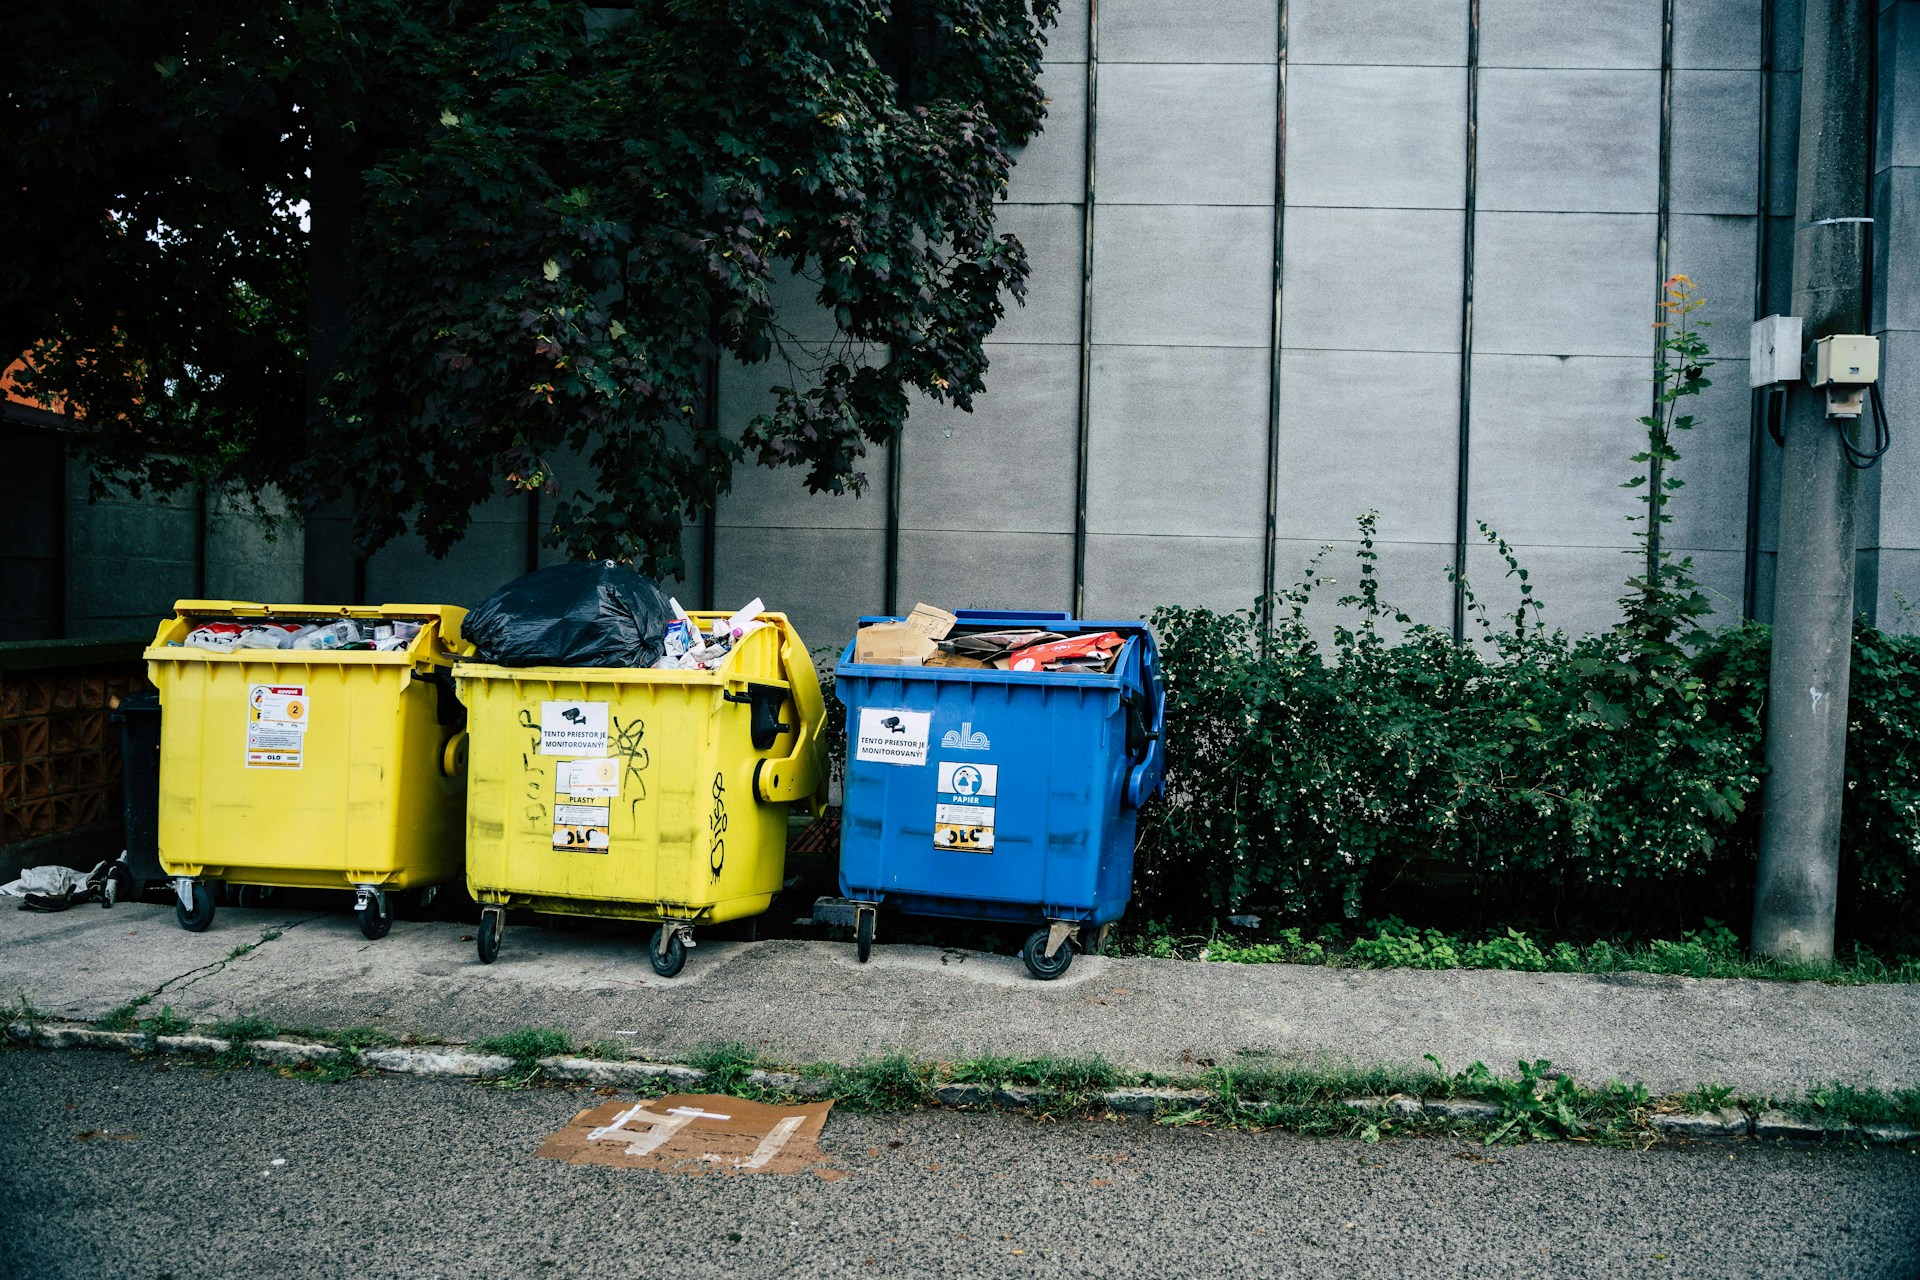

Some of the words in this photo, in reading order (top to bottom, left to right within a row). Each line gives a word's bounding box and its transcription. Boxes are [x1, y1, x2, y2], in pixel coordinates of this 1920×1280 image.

[292, 706, 299, 714] 2
[861, 737, 883, 745] TENTO
[884, 739, 917, 747] PRIESTOR
[918, 741, 925, 749] JE
[862, 747, 922, 758] MONITOROVANÝ!
[604, 768, 608, 776] 2
[569, 796, 595, 804] PLASTY
[952, 796, 980, 804] PAPIER
